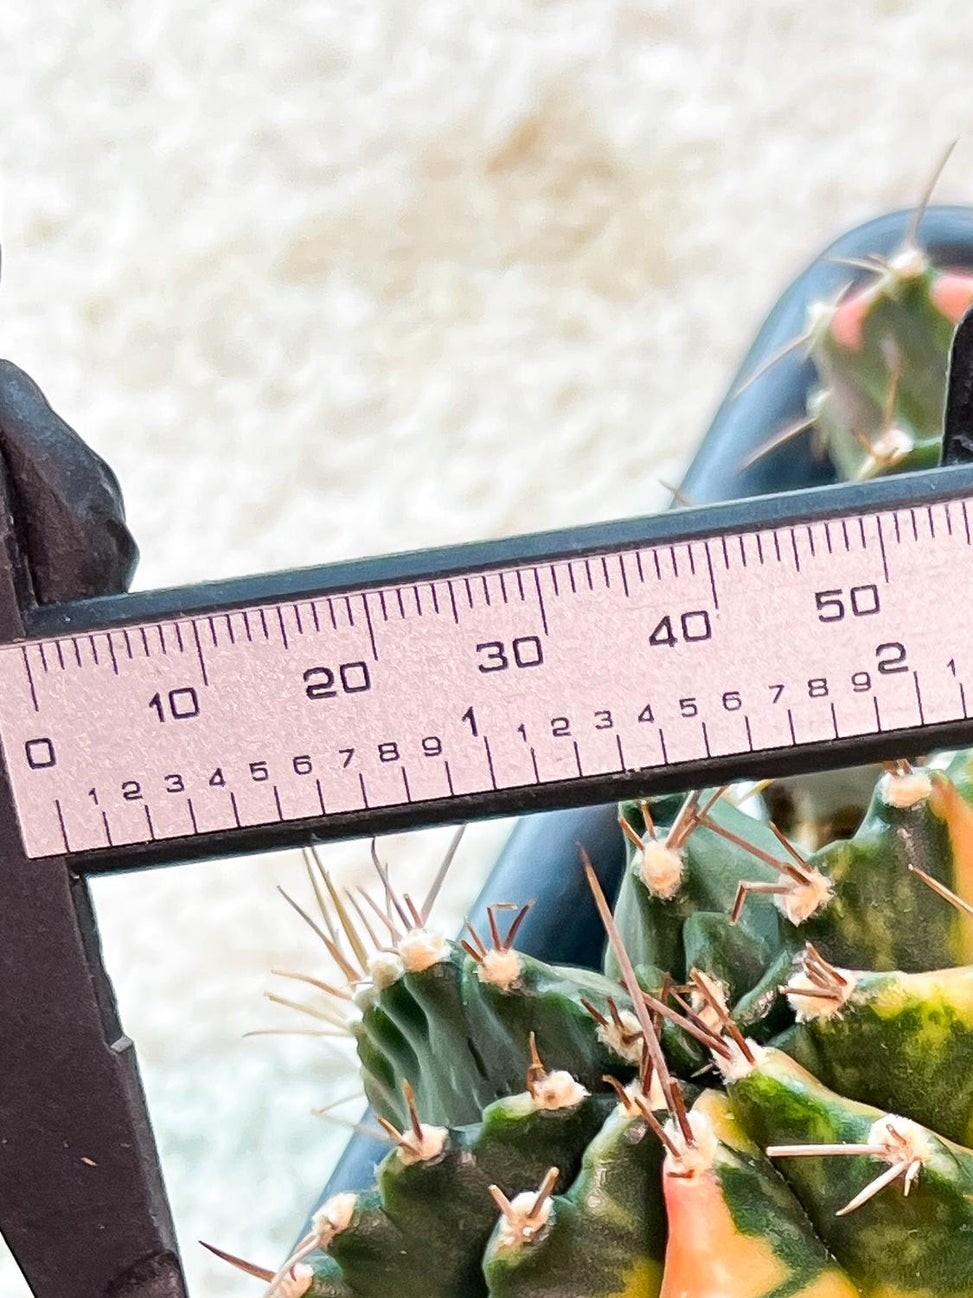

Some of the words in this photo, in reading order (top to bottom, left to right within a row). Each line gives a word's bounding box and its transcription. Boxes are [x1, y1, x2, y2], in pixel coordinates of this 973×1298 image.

[24, 737, 57, 770] 0
[148, 687, 200, 723] 10
[302, 661, 371, 700] 20
[476, 635, 544, 673] 30
[648, 610, 712, 648] 40
[814, 584, 881, 622] 50
[88, 787, 99, 806] 1
[121, 780, 144, 801] 2
[164, 774, 185, 793] 3
[208, 767, 226, 788] 4
[248, 760, 269, 782] 5
[292, 754, 313, 776] 6
[338, 748, 355, 769] 7
[377, 741, 400, 763] 8
[421, 736, 443, 757] 9
[461, 706, 478, 737] 1
[517, 723, 527, 742] 1
[550, 716, 572, 738] 2
[594, 710, 614, 730] 3
[637, 703, 655, 724] 4
[678, 697, 698, 718] 5
[721, 690, 742, 712] 6
[768, 684, 785, 704] 7
[807, 677, 829, 698] 8
[851, 671, 872, 693] 9
[875, 641, 909, 675] 2
[947, 658, 956, 677] 1
